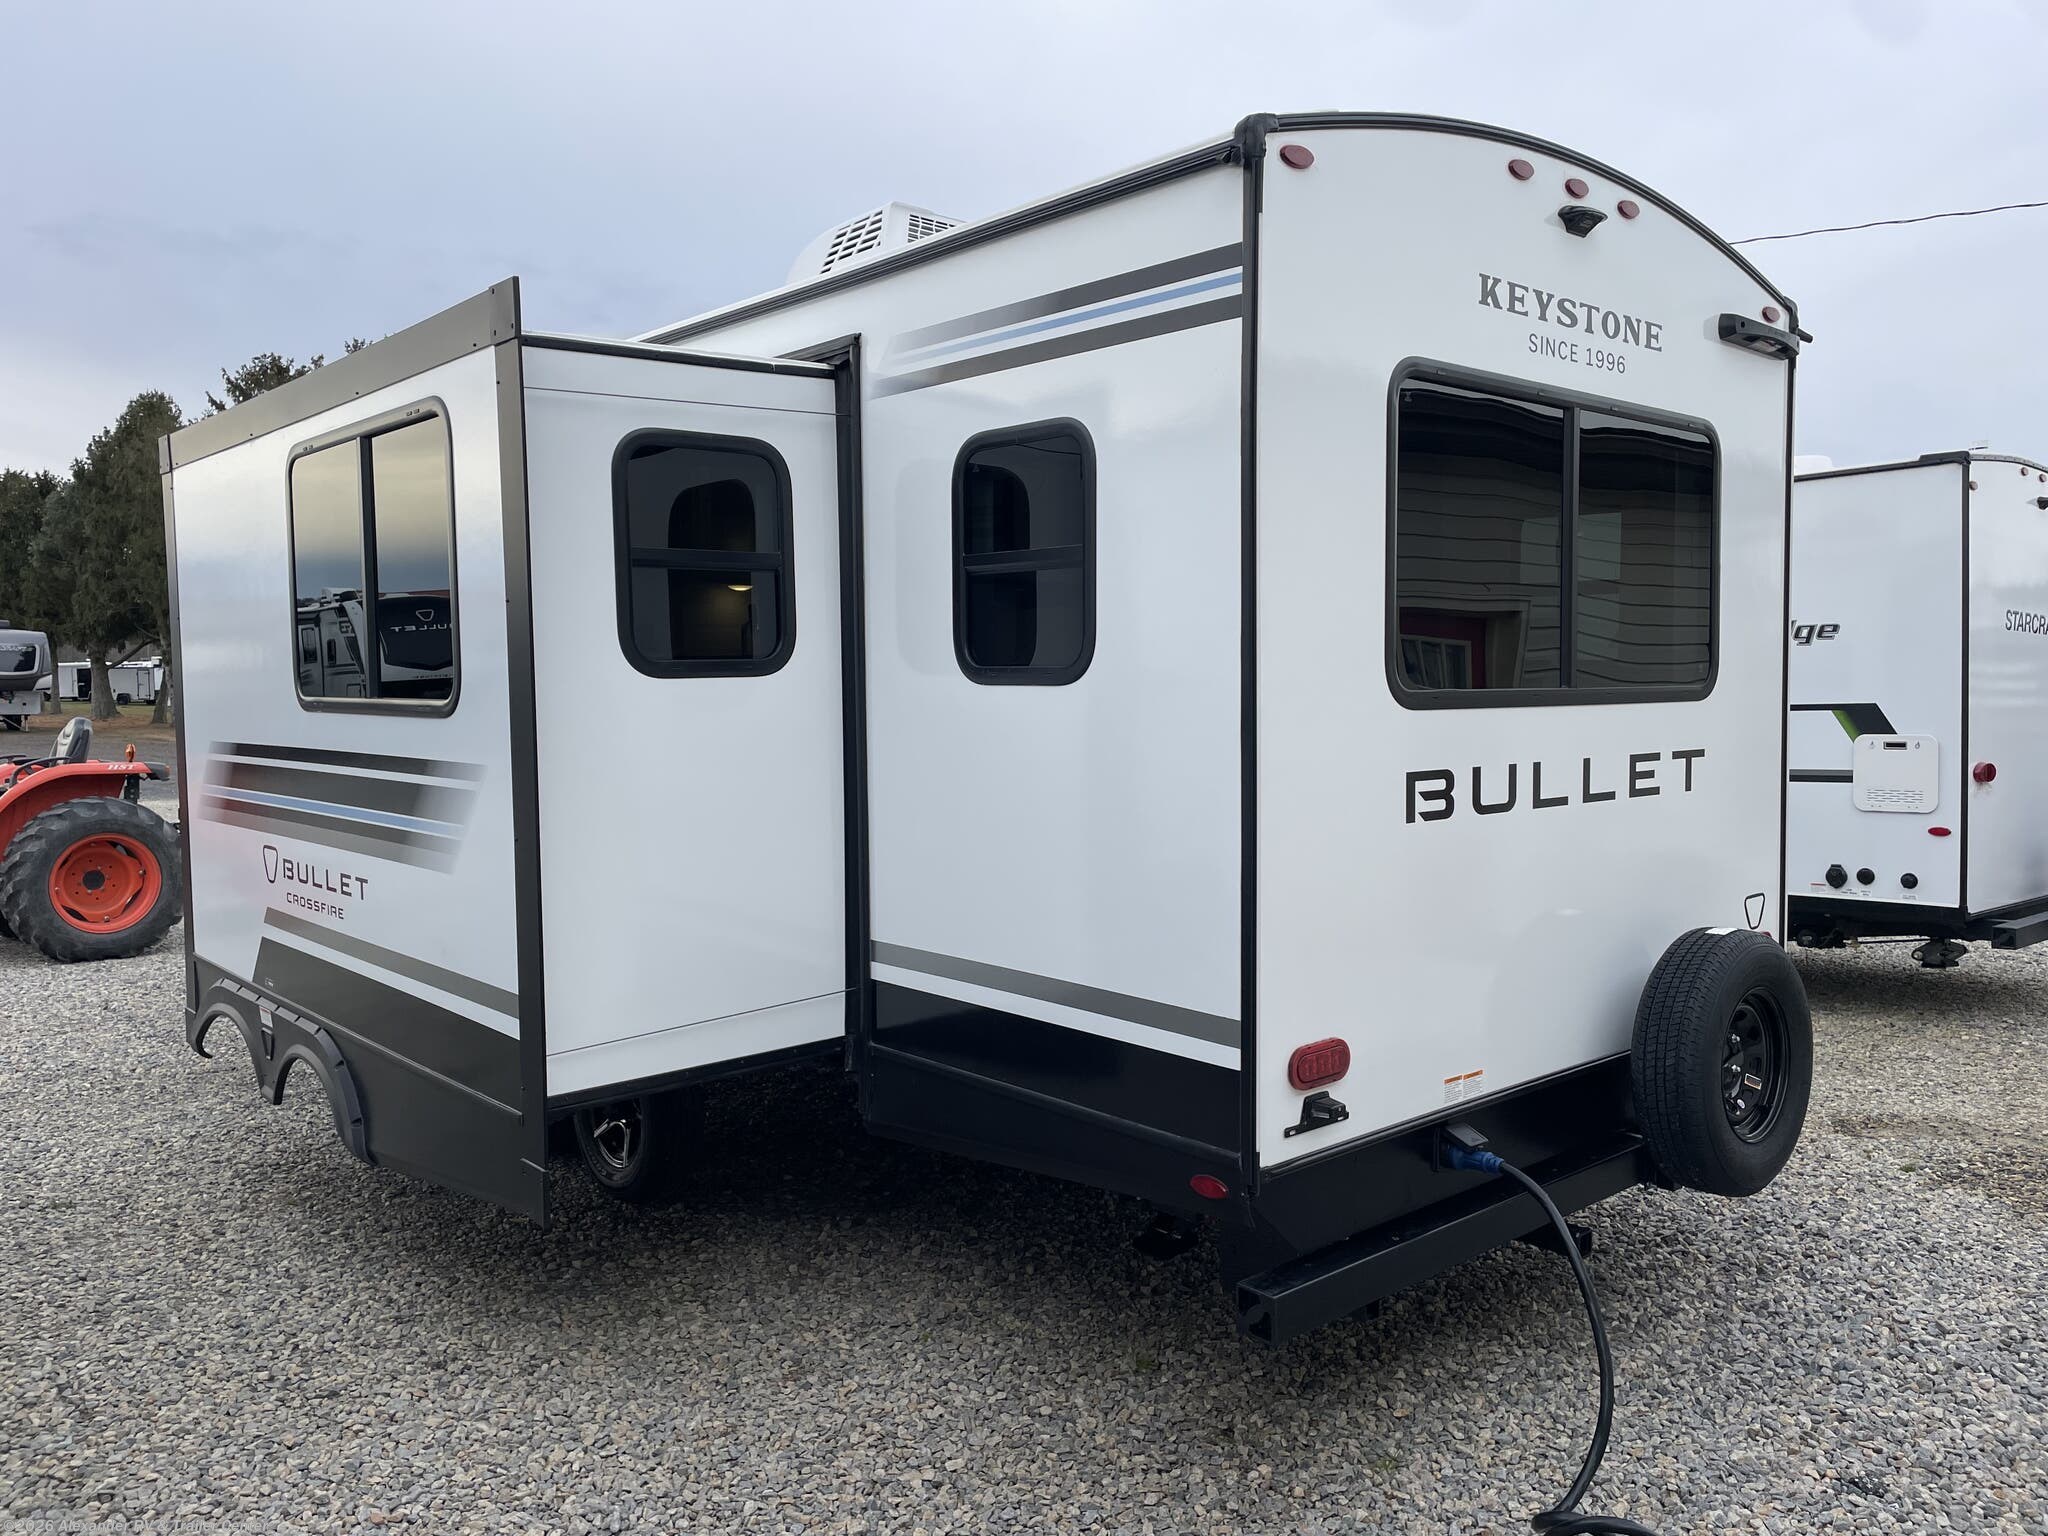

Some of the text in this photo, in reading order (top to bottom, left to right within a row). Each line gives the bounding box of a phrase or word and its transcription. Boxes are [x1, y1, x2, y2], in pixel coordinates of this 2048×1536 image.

[1478, 273, 1663, 352] KEYSTONE
[1528, 333, 1627, 374] SINCE 1996
[1791, 620, 1841, 646] ge
[1405, 748, 1706, 824] BULLET
[282, 858, 369, 901] BULLET
[286, 892, 345, 920] CROSSFIRE
